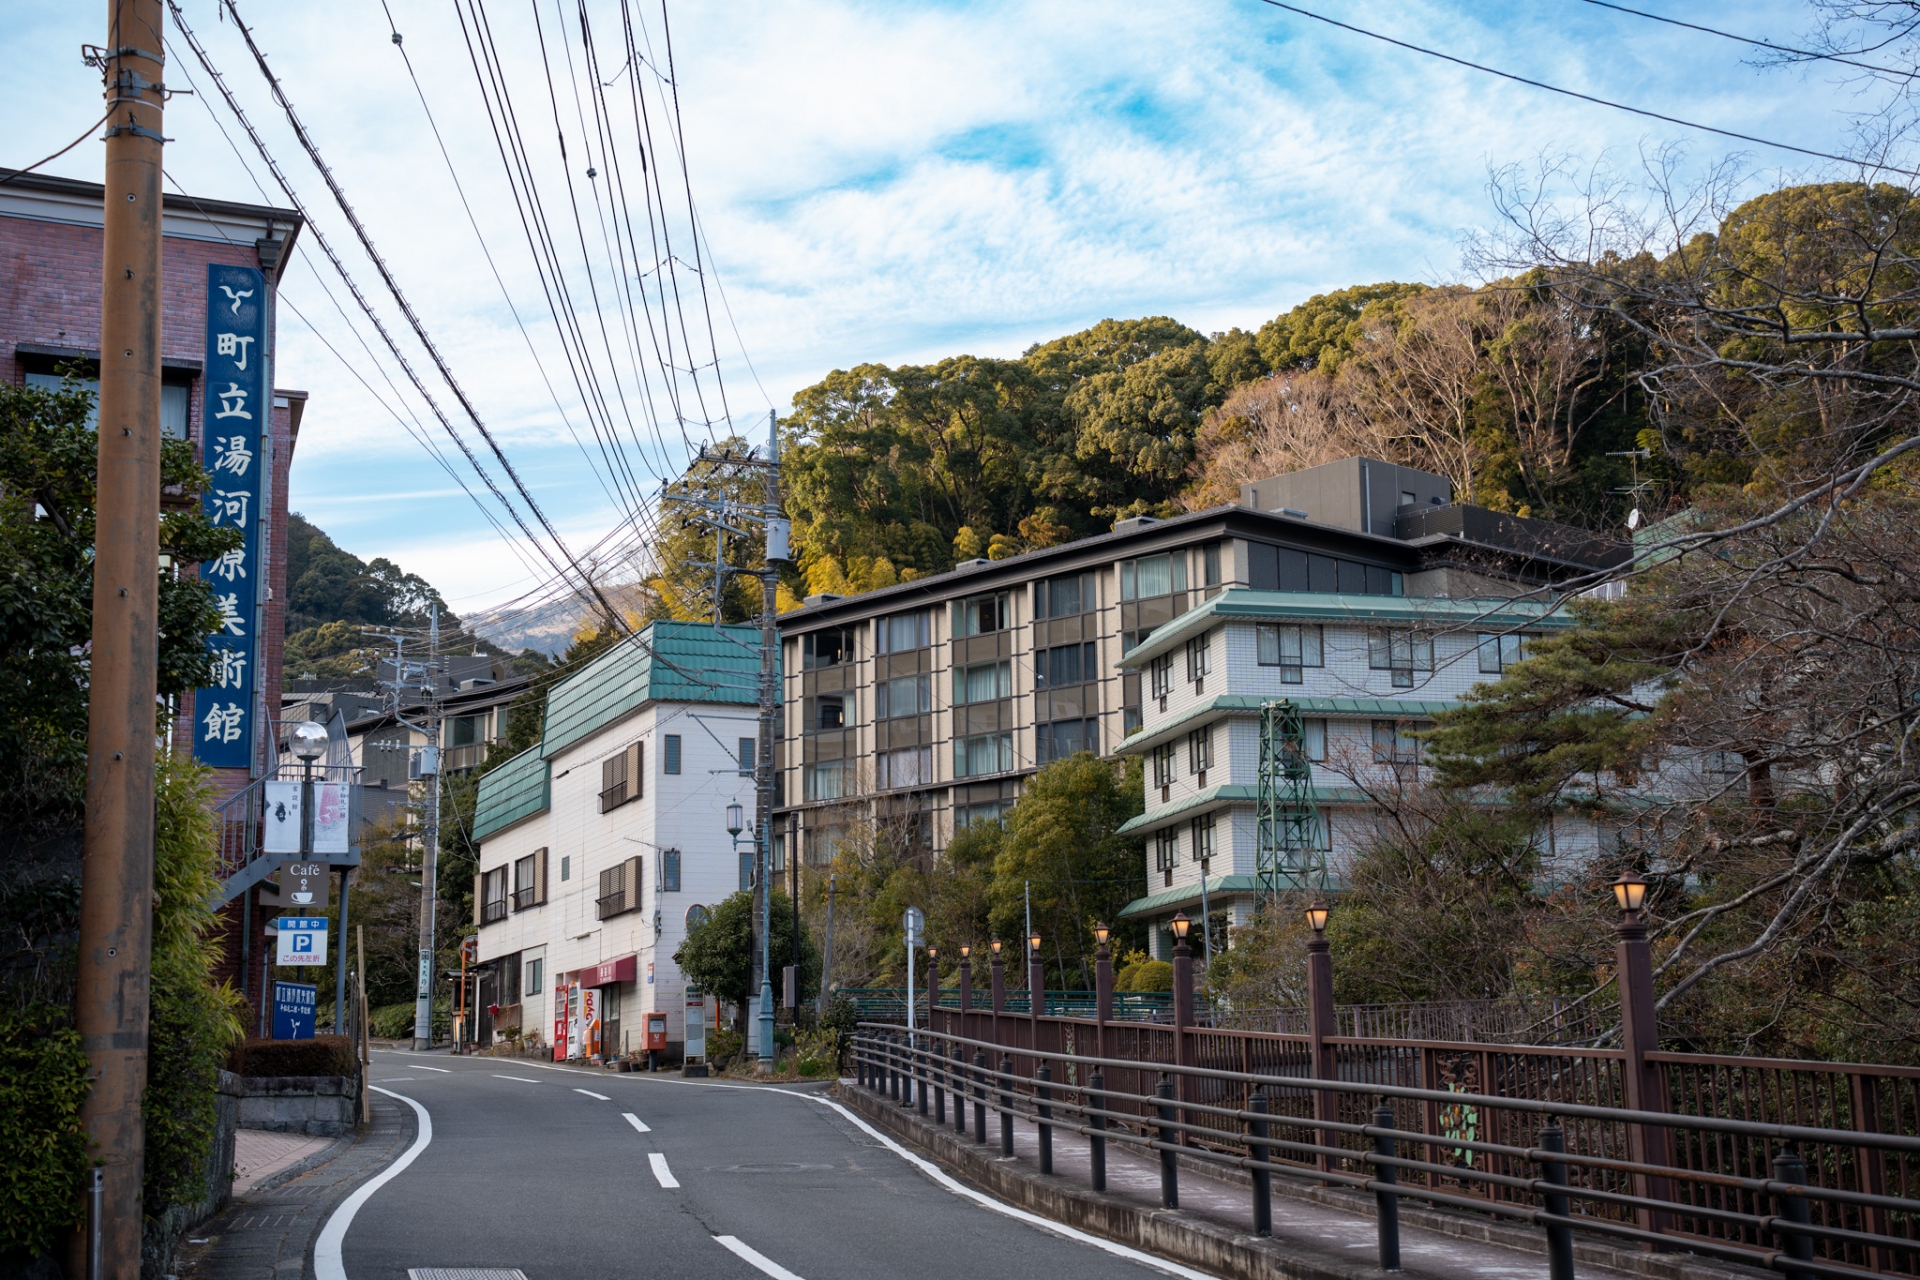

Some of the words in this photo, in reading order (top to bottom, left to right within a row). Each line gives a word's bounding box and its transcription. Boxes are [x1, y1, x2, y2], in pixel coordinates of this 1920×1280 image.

[203, 332, 255, 744] 町立湯河原美術館
[290, 864, 320, 876] Café
[287, 920, 320, 929] 開館中
[296, 935, 310, 951] P
[282, 954, 320, 963] この先左折
[585, 991, 595, 1020] DyDo
